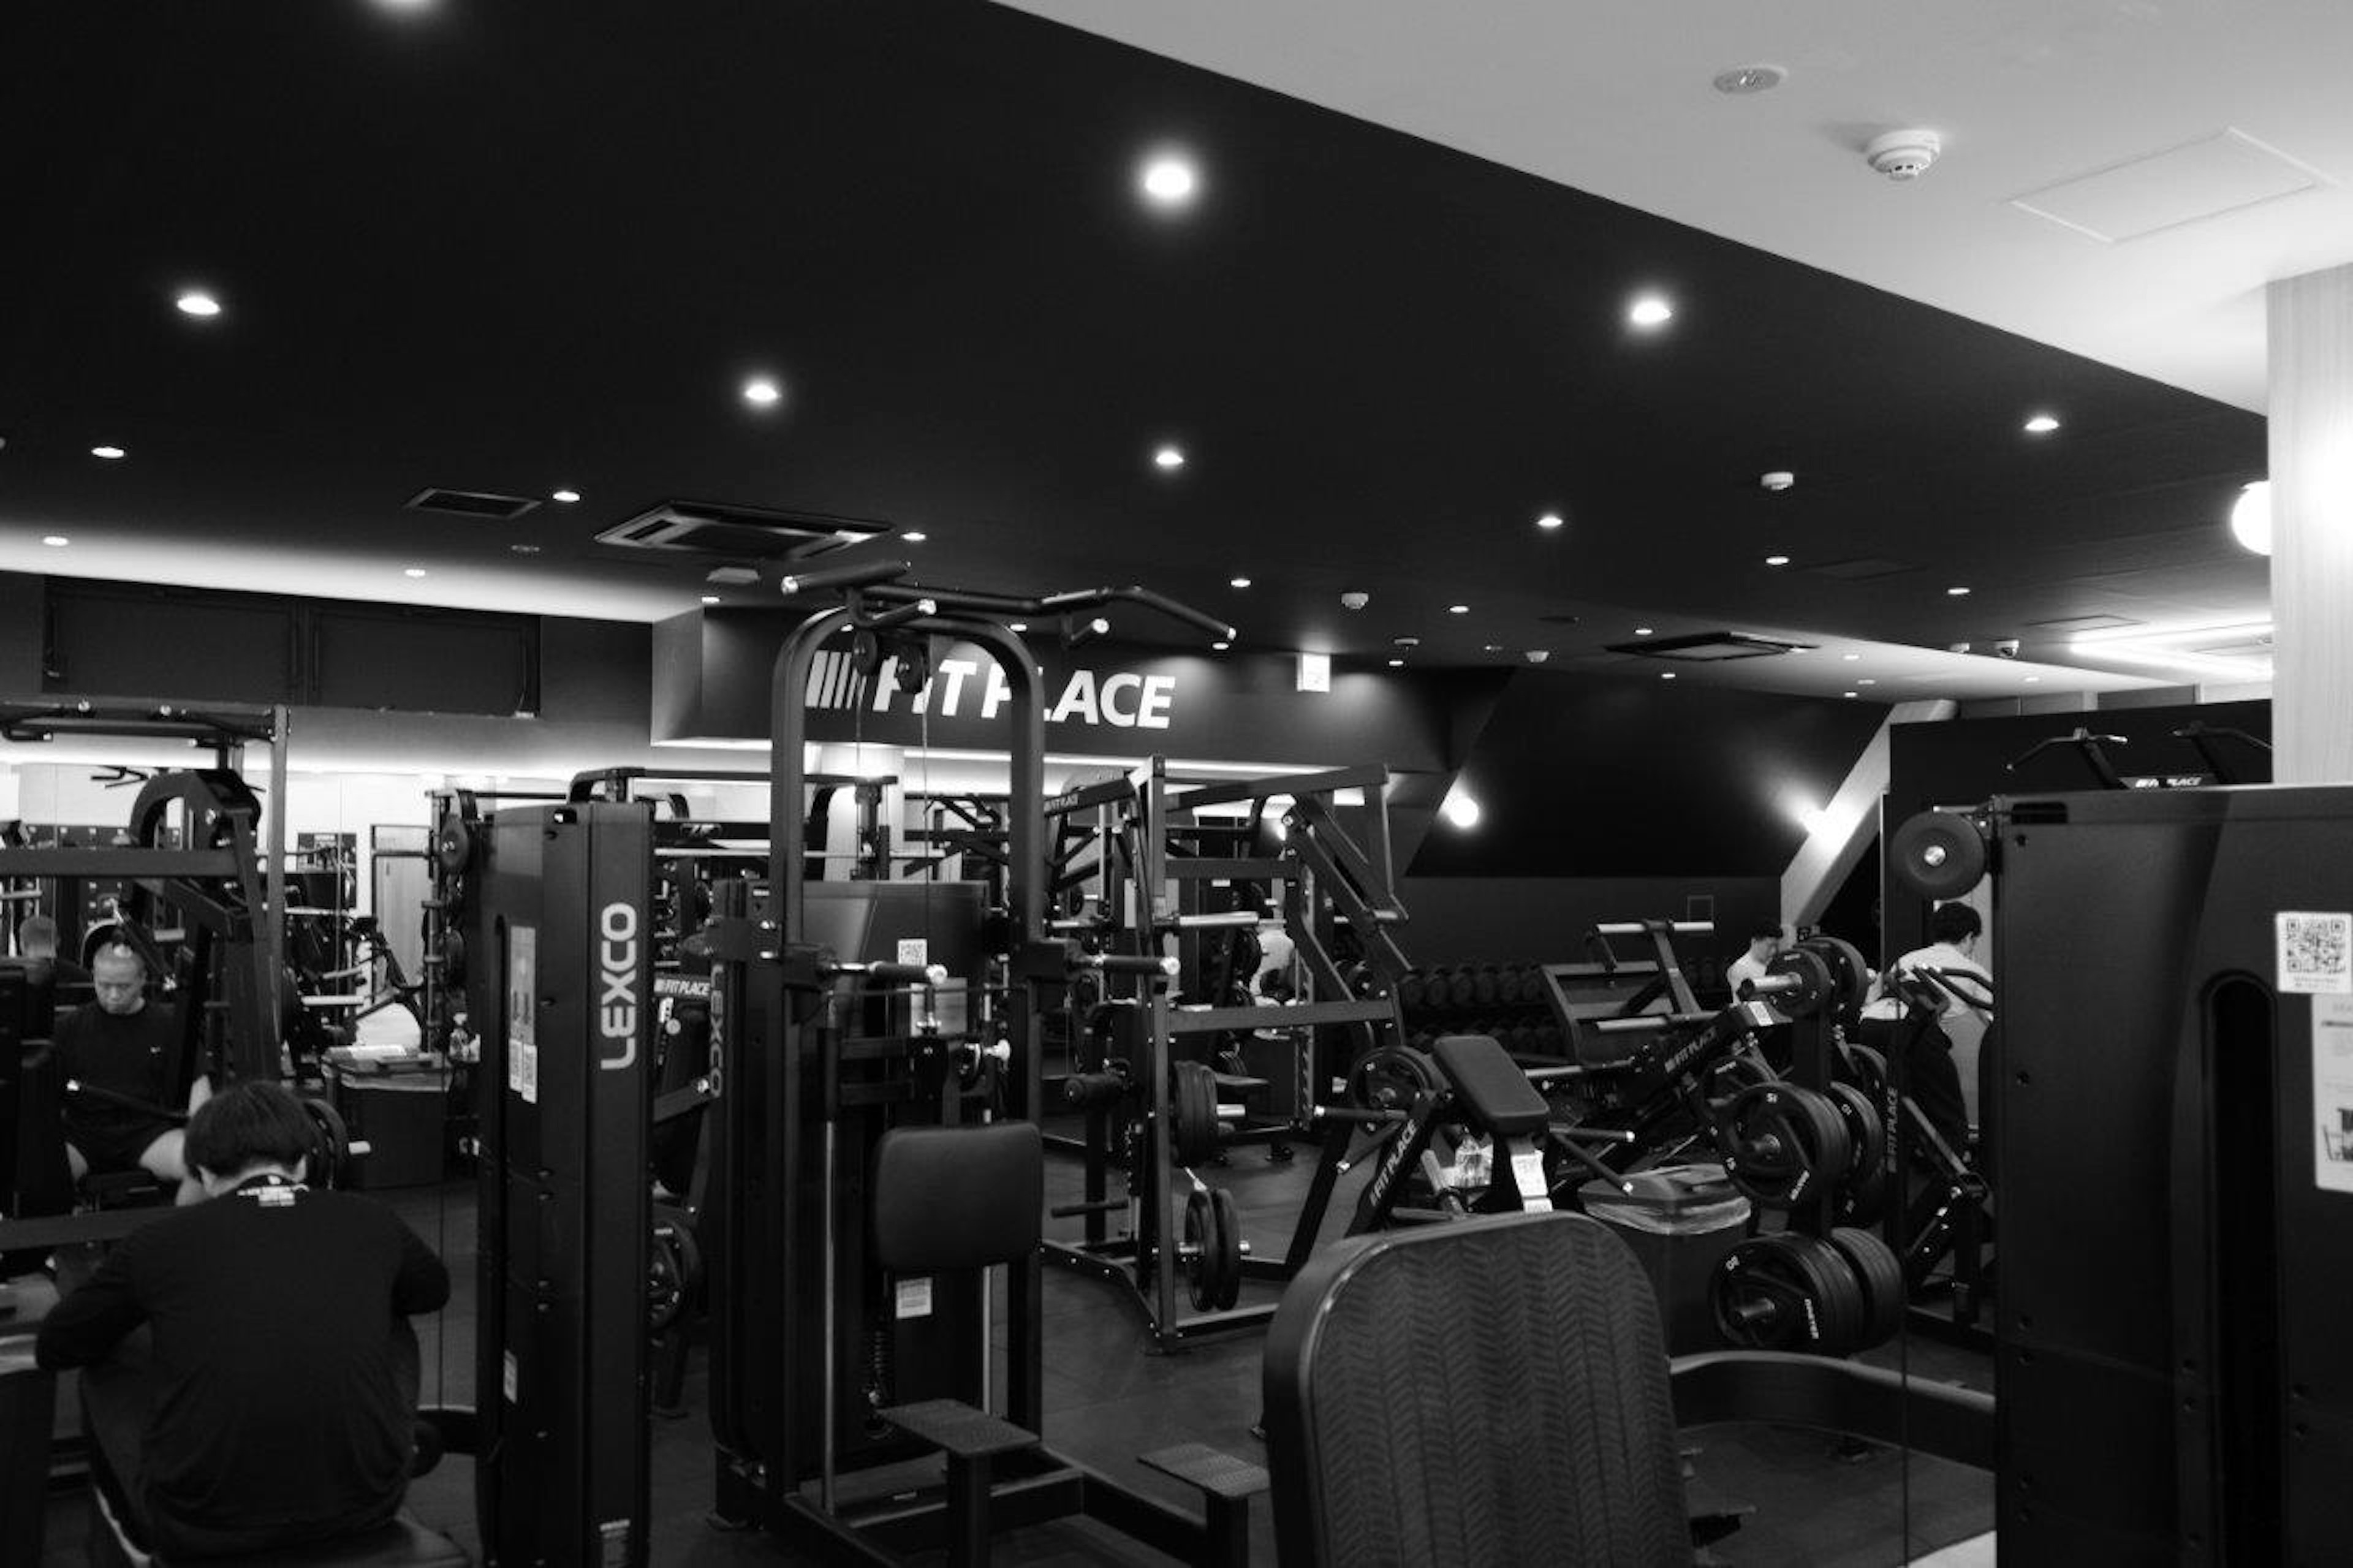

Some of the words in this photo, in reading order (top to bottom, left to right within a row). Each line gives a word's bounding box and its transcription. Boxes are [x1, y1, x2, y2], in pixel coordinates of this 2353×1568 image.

[981, 663, 1175, 729] PACE
[601, 903, 636, 1070] LEXCO
[710, 964, 724, 1097] LEXCO
[1387, 1118, 1417, 1175] PLACE
